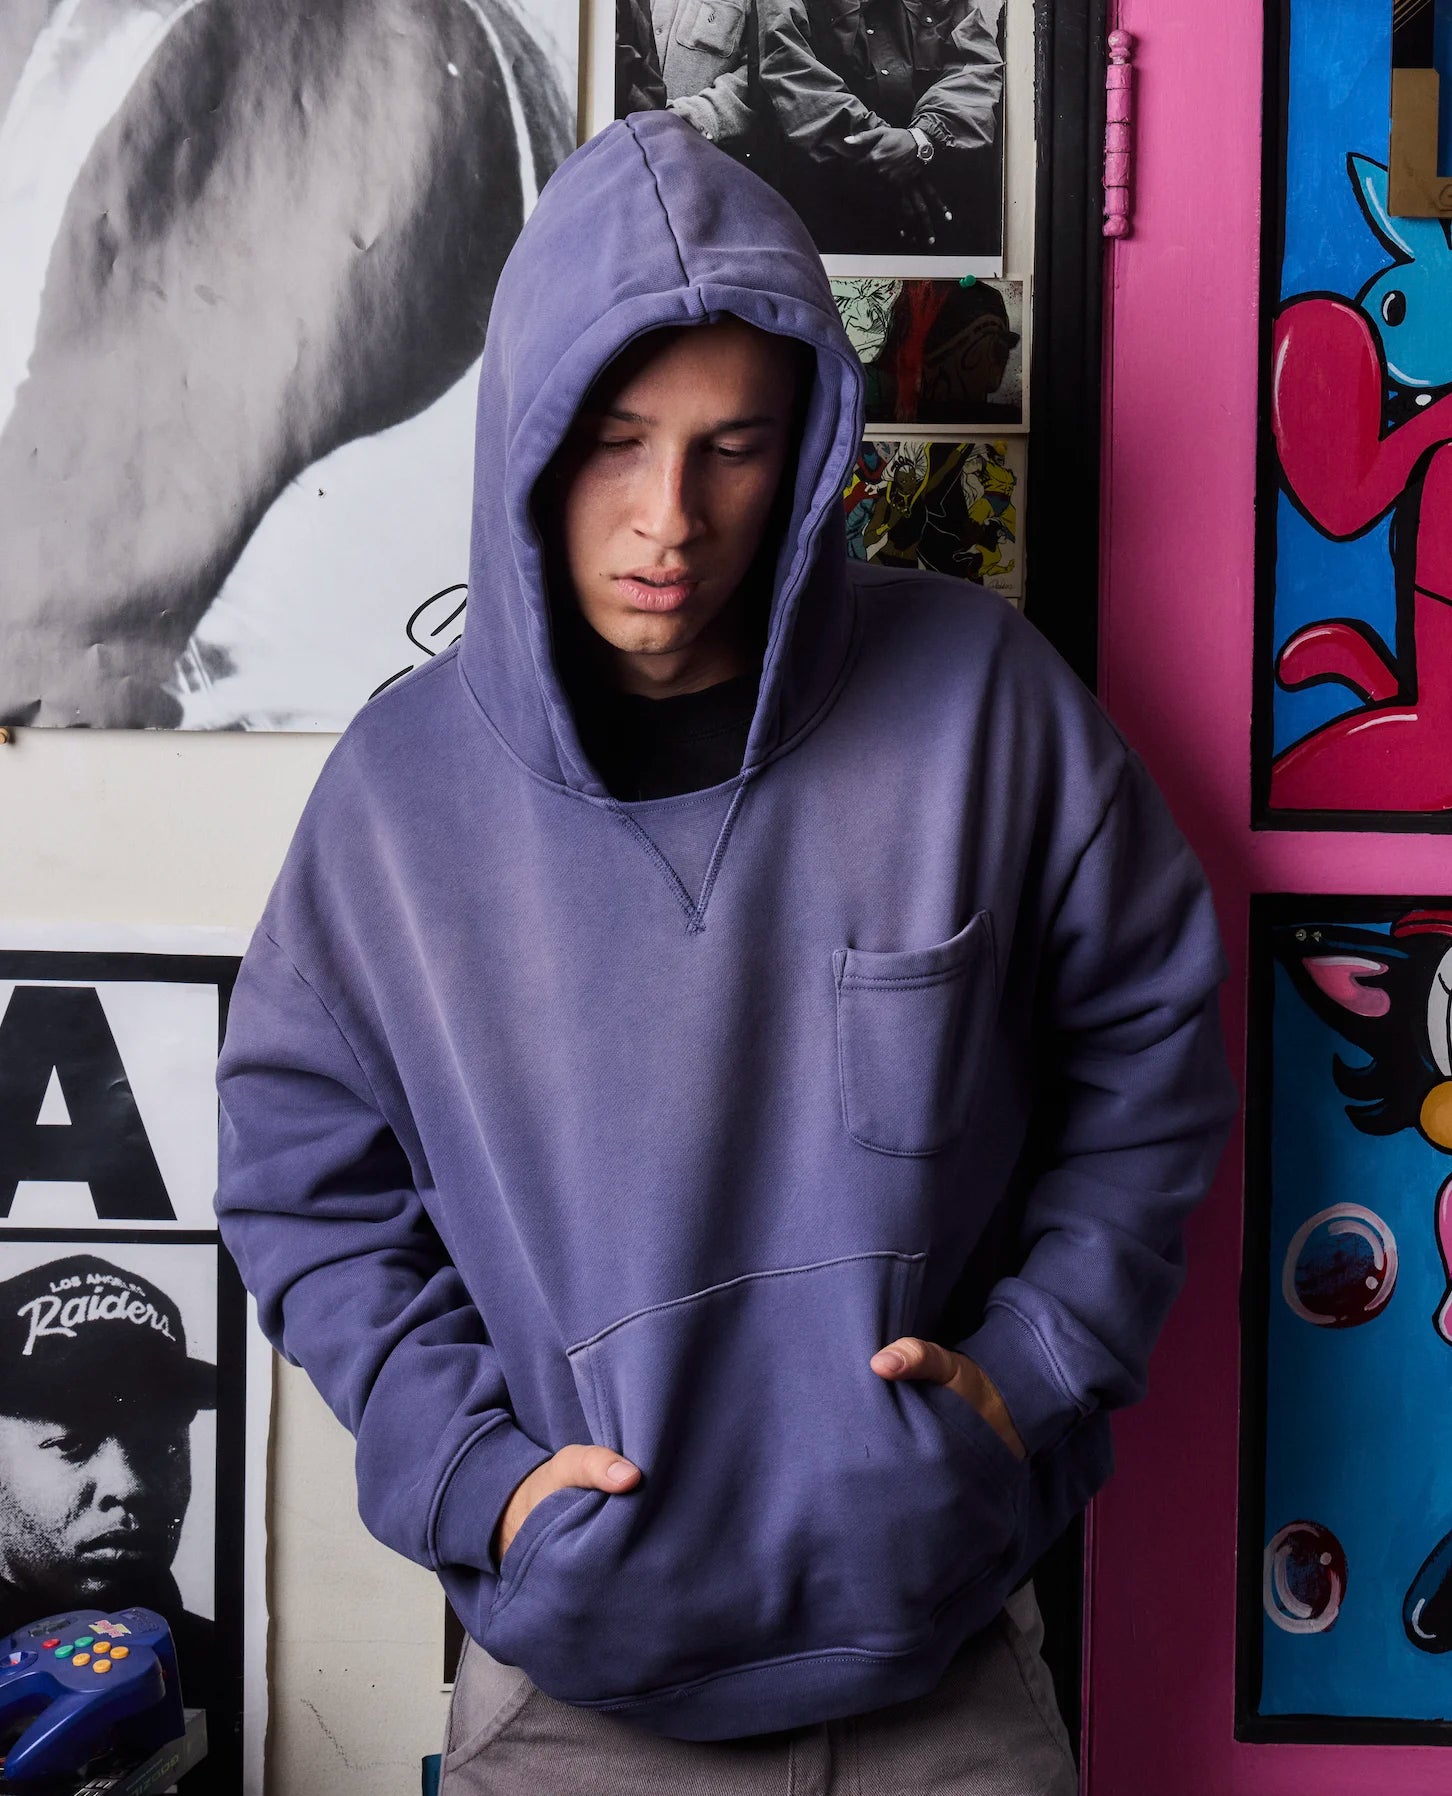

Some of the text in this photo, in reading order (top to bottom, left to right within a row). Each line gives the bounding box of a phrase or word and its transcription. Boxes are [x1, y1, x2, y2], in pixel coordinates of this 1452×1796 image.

[0, 985, 178, 1220] A
[49, 1275, 82, 1293] LOS
[17, 1286, 177, 1356] Raiders
